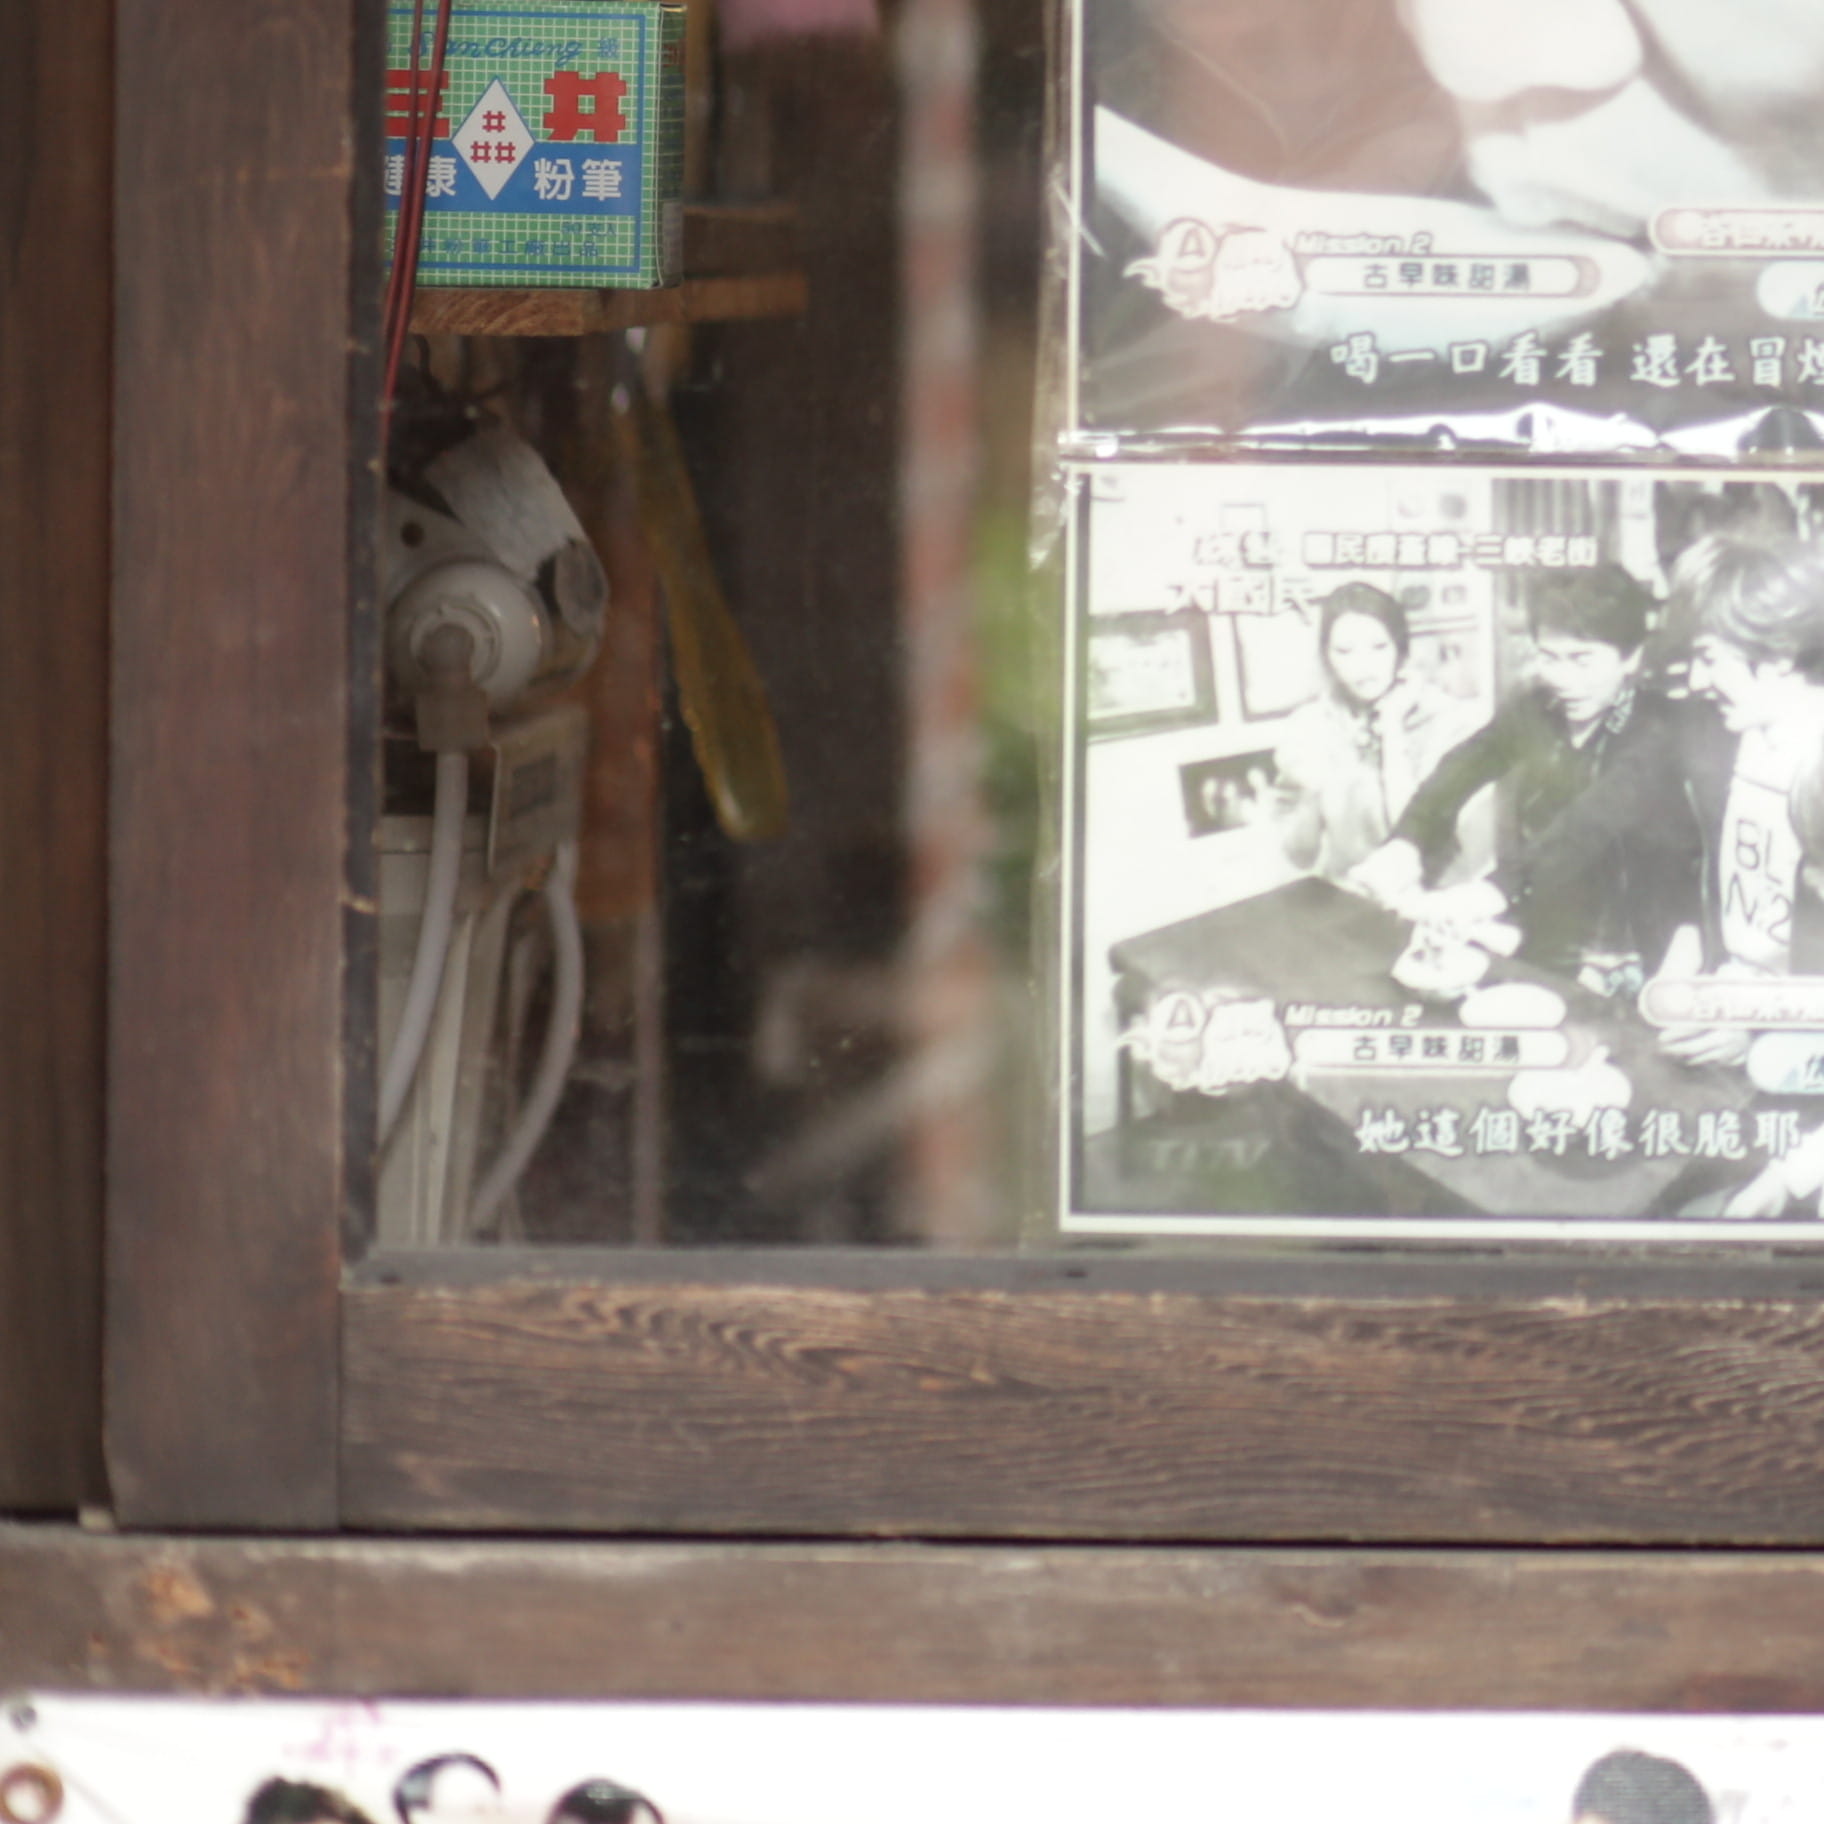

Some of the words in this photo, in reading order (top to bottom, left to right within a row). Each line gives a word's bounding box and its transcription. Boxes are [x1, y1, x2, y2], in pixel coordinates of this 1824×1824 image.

[533, 156, 623, 201] 粉筆
[1330, 331, 1605, 387] 喝一口看看
[1355, 1107, 1801, 1161] 她這個好像很脆耶
